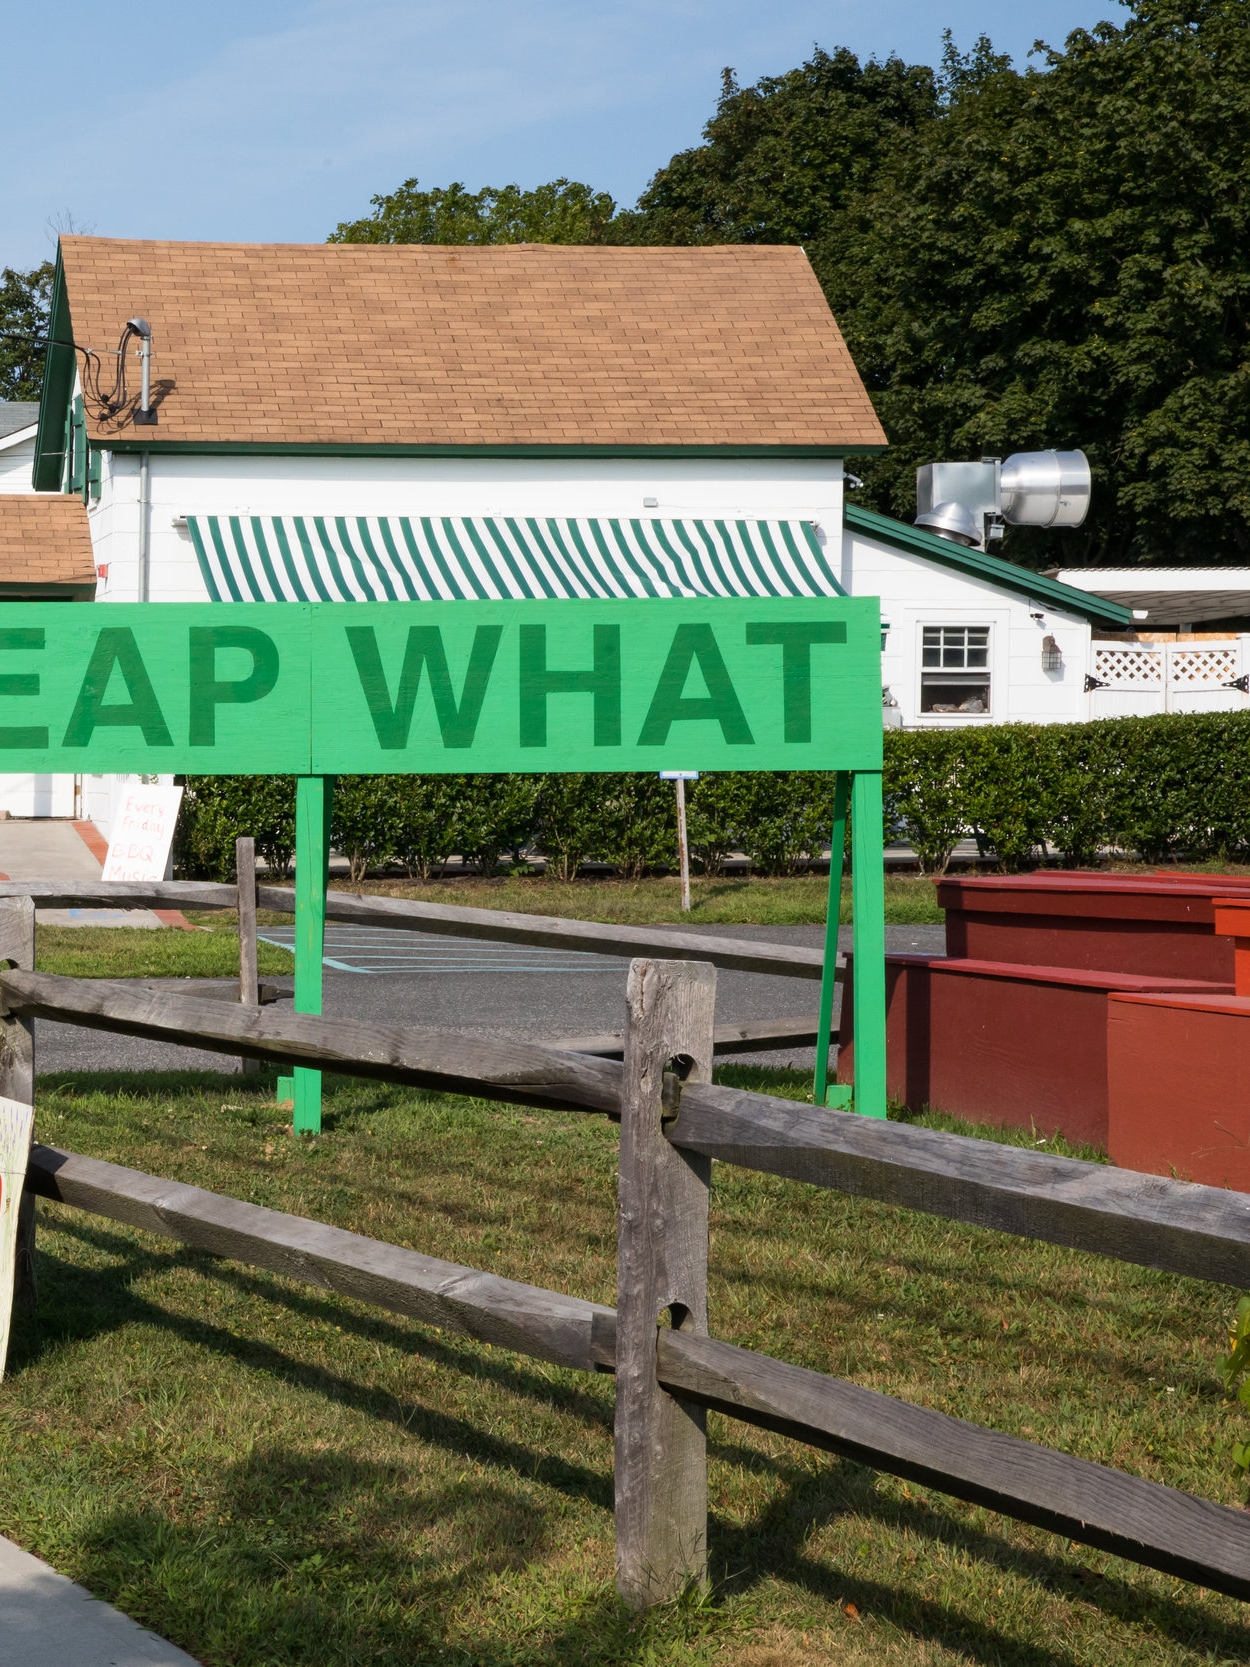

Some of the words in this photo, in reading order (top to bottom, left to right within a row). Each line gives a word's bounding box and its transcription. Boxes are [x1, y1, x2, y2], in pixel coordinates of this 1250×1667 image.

[344, 621, 847, 749] WHAT
[126, 796, 165, 817] Every
[112, 843, 154, 863] BBQ
